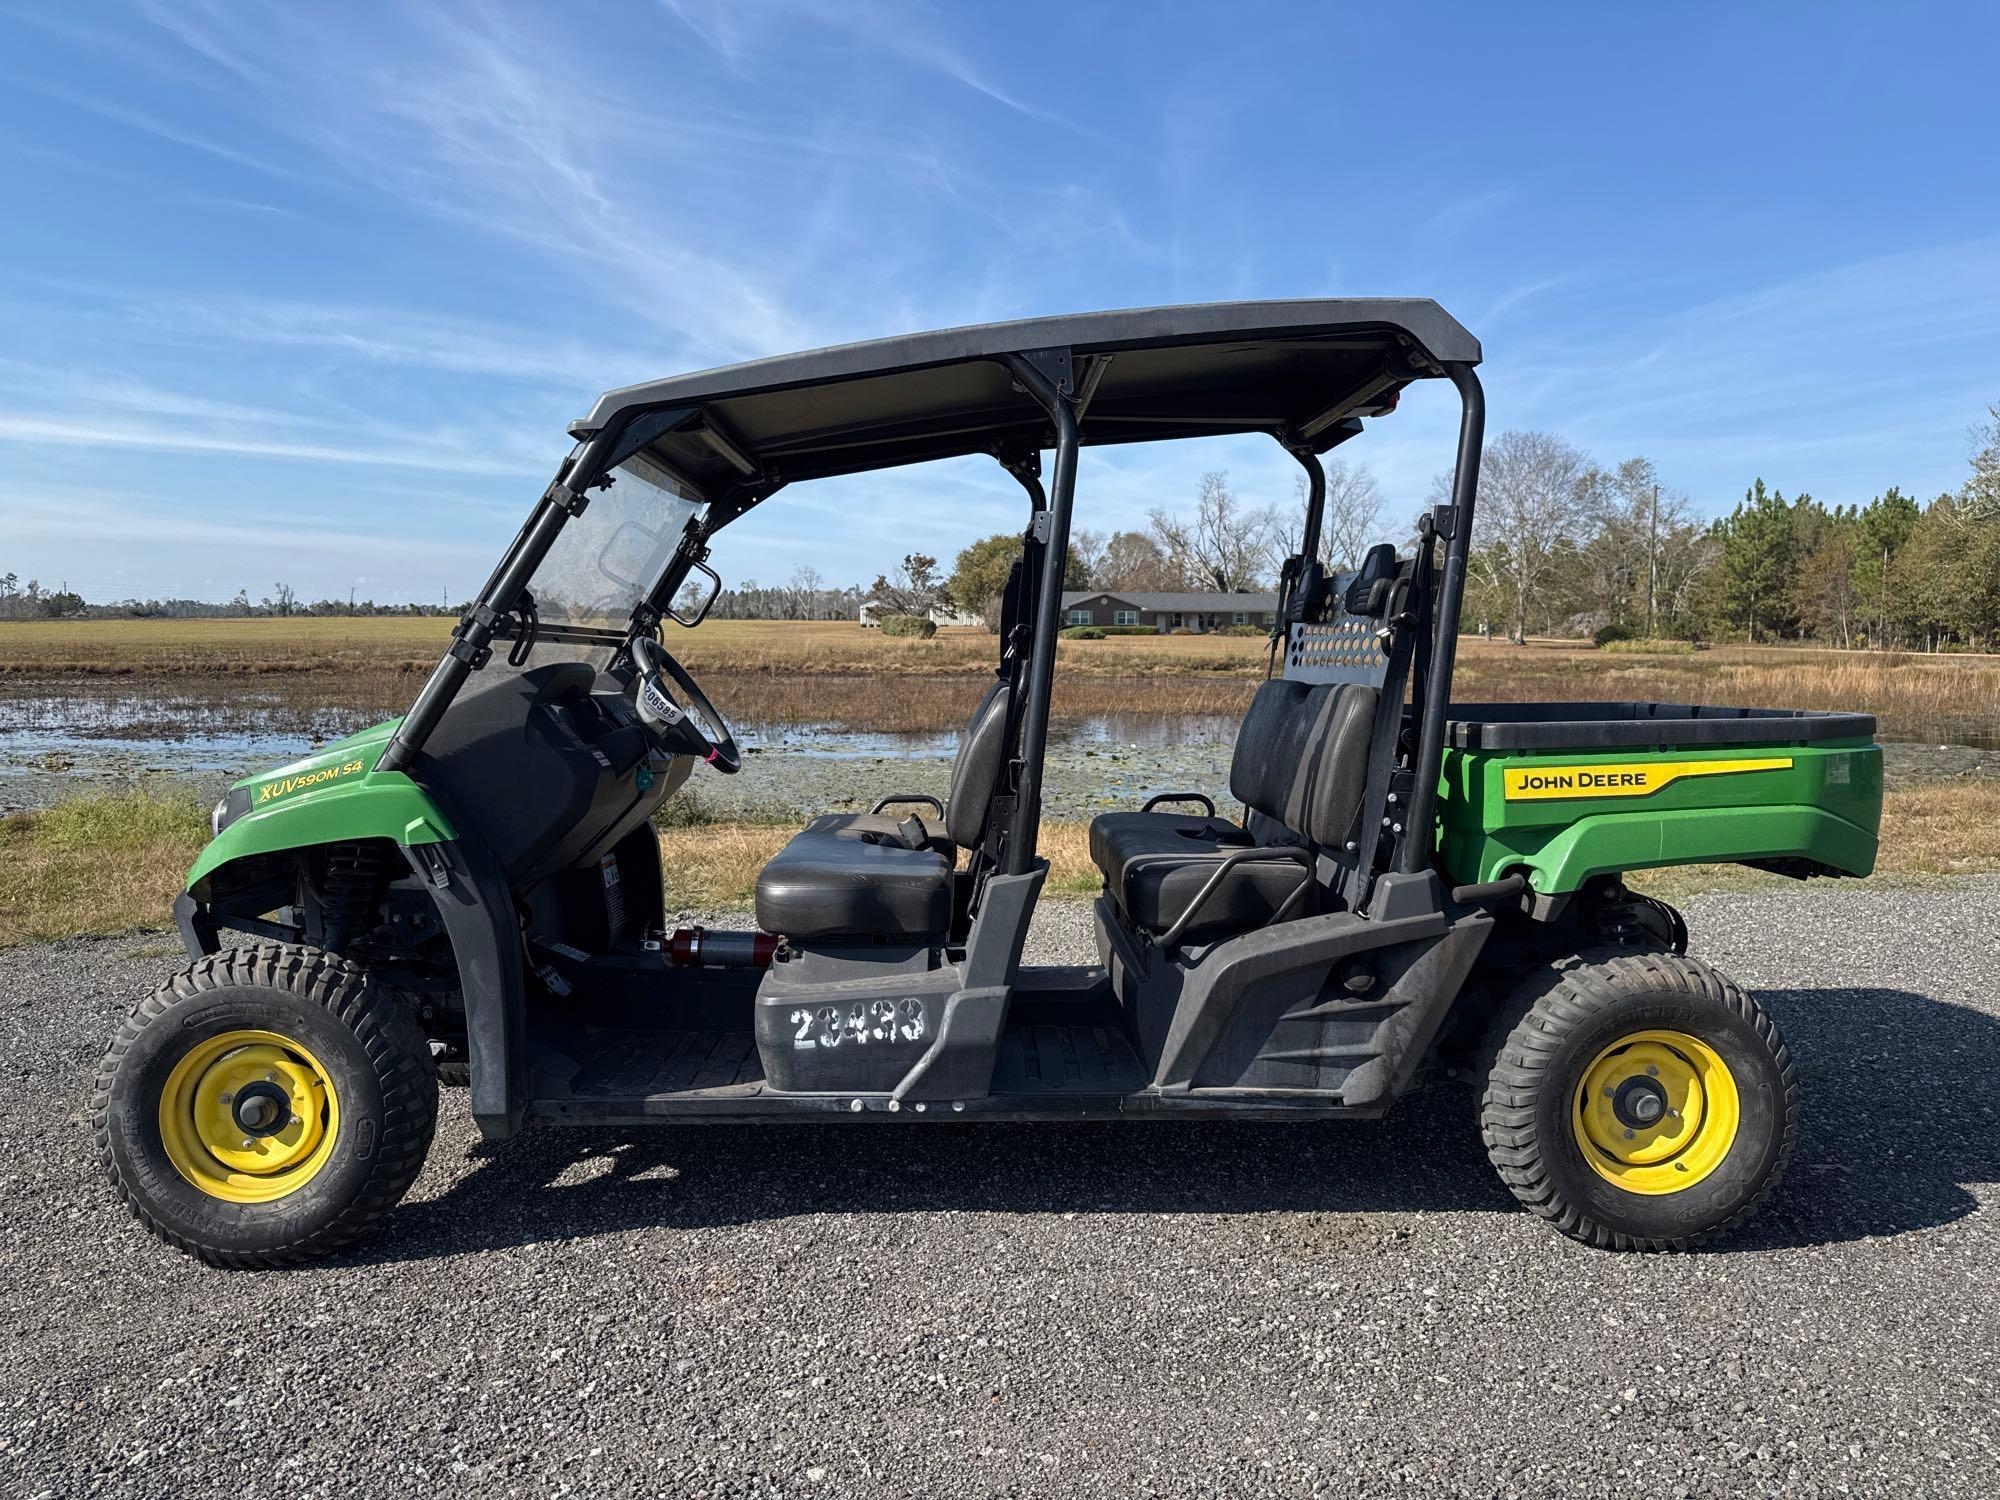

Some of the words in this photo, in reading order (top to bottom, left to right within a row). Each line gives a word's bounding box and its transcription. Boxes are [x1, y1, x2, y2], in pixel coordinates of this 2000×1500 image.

[644, 686, 677, 718] 206585
[256, 766, 340, 805] XUV590M
[342, 760, 364, 775] S4
[1517, 774, 1573, 790] JOHN
[1578, 772, 1647, 788] DEERE
